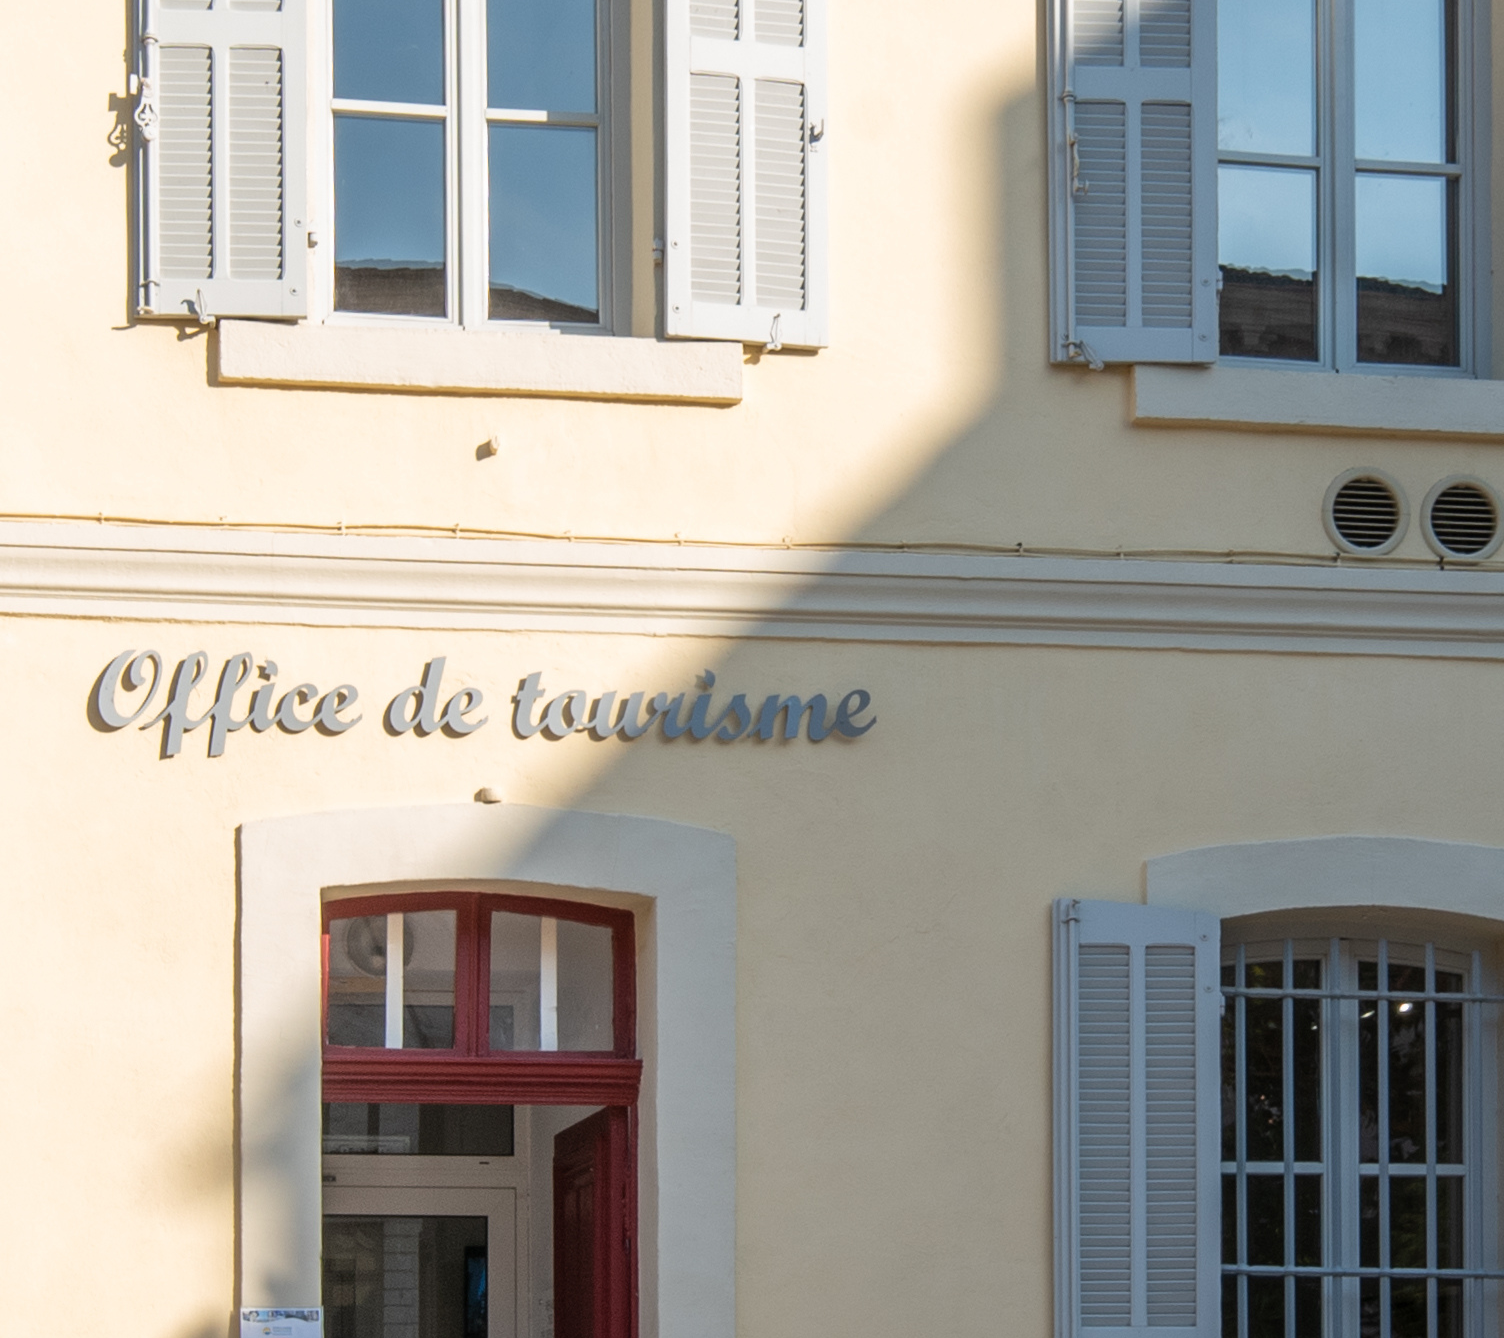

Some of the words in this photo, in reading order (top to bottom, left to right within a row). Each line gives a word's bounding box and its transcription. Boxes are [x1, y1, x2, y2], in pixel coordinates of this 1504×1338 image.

[87, 649, 362, 760] Office
[384, 656, 488, 738] de
[510, 669, 878, 743] tourisme
